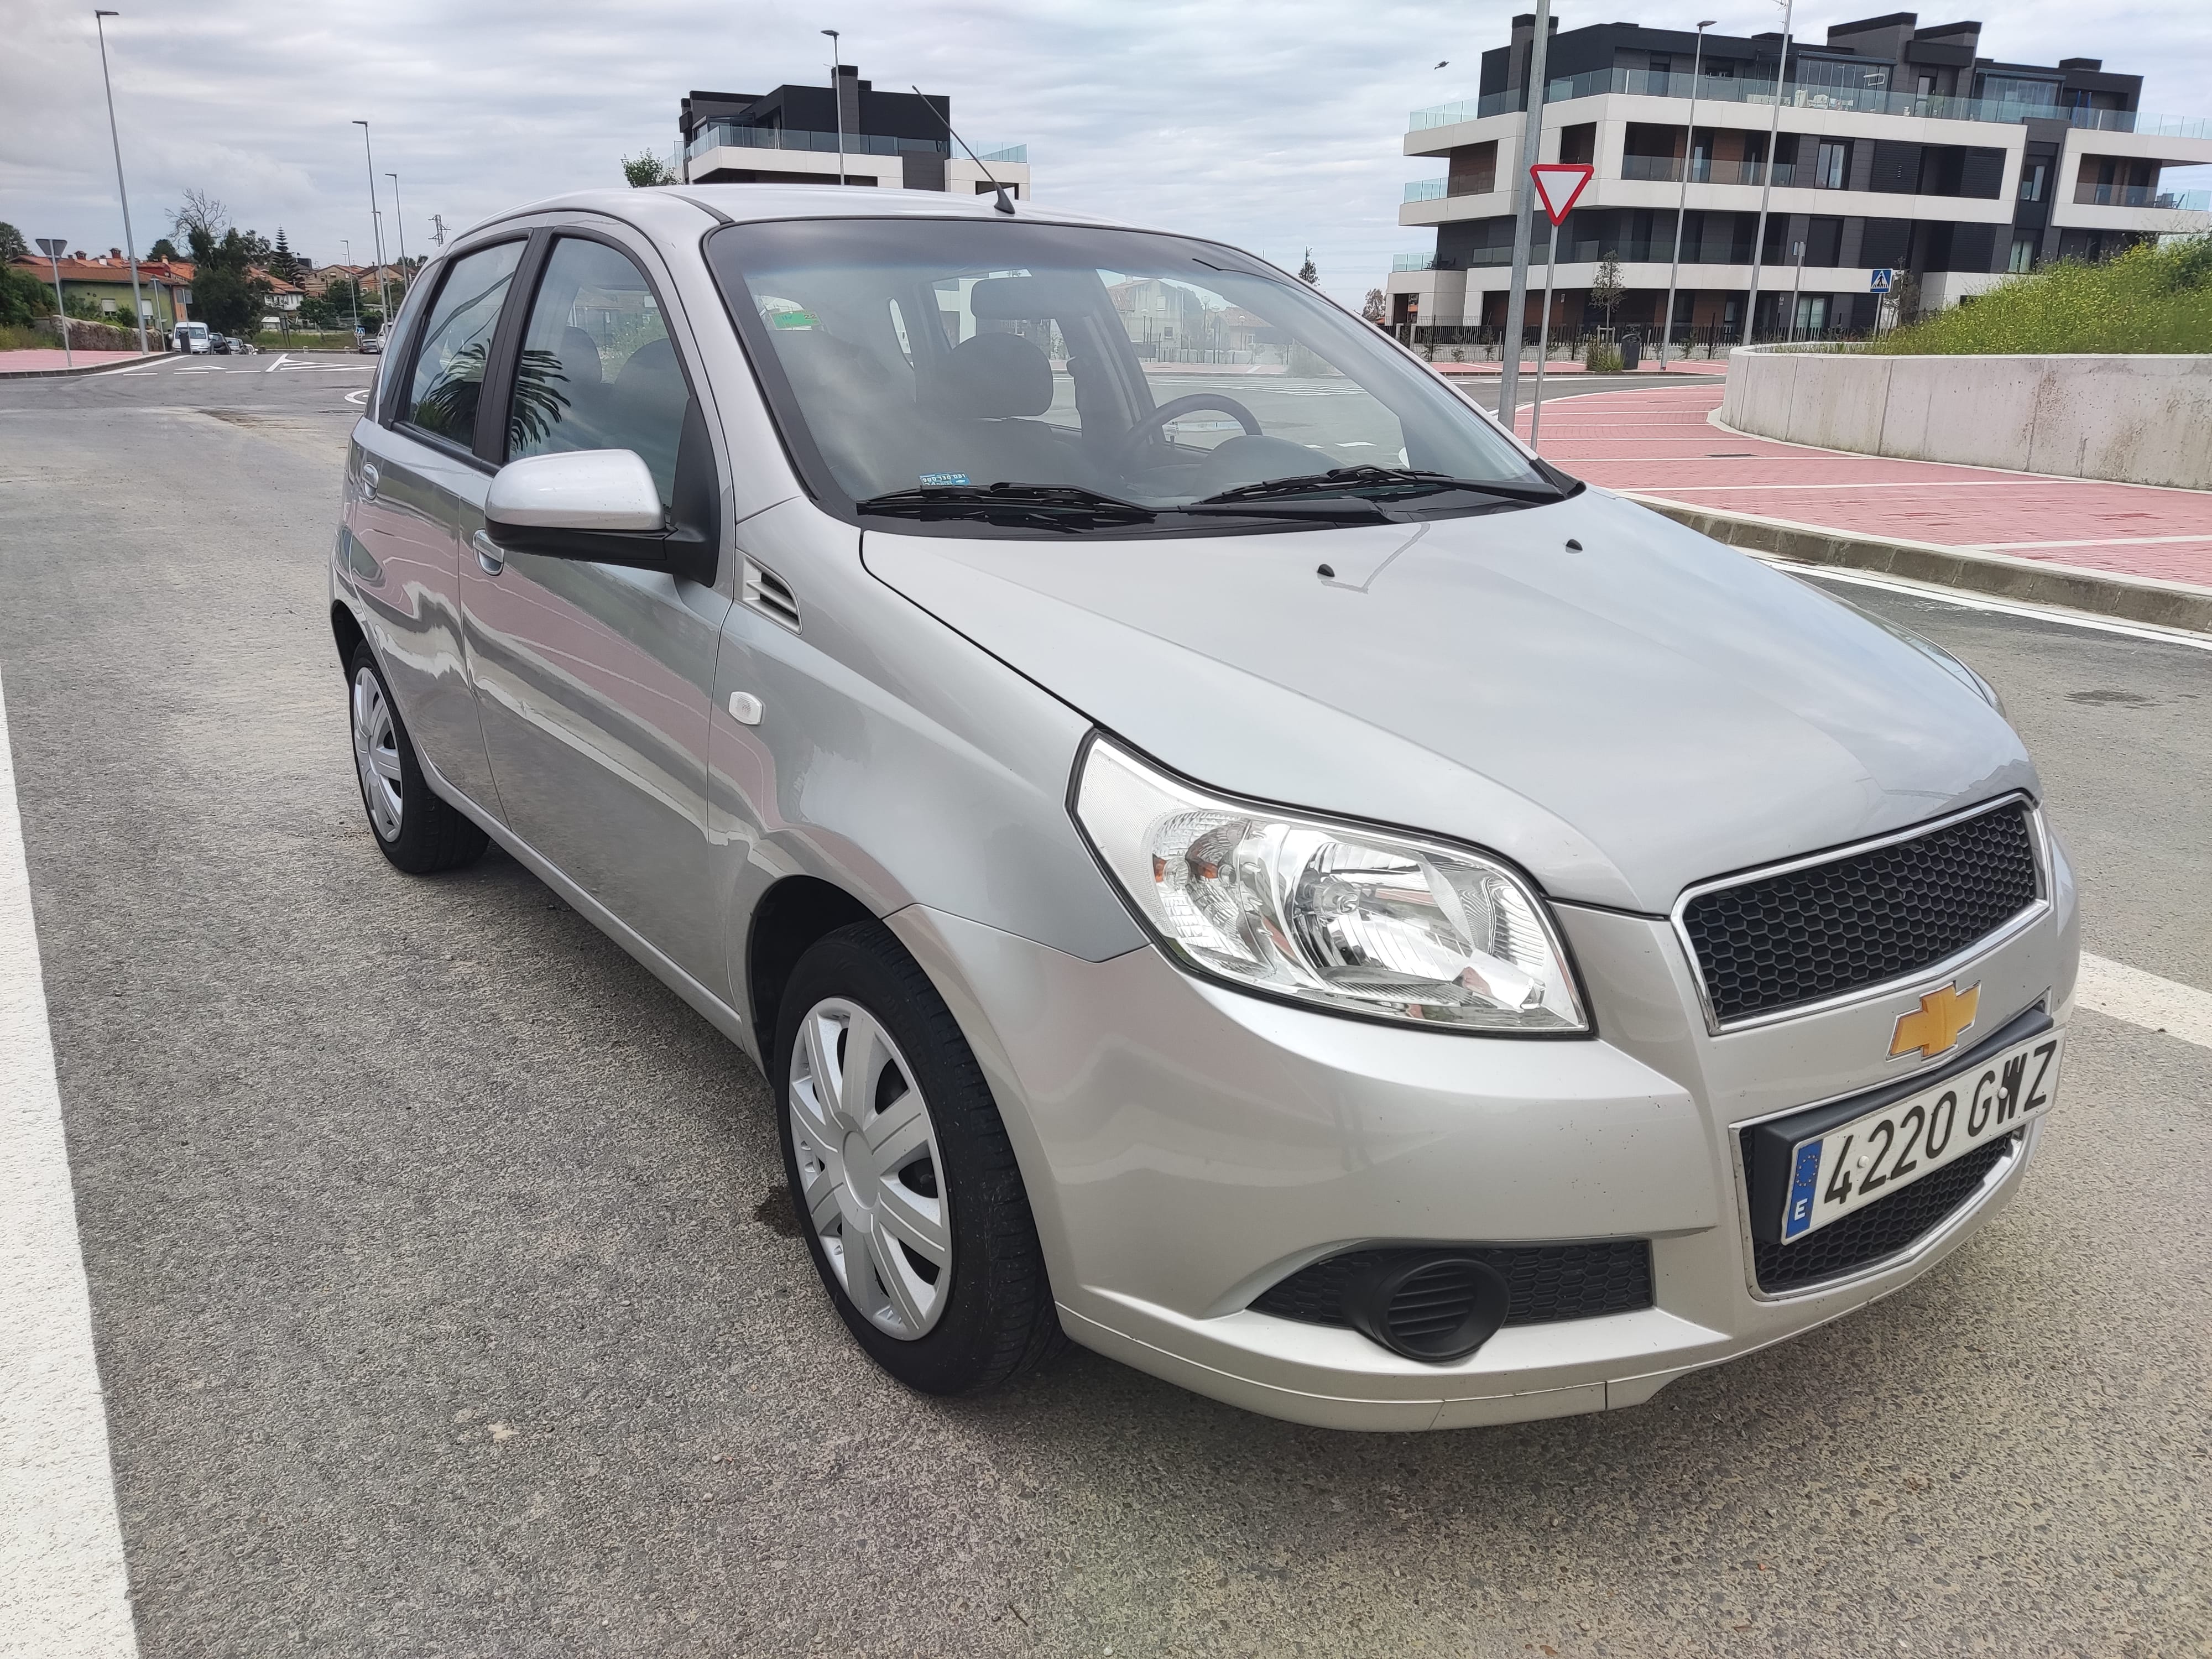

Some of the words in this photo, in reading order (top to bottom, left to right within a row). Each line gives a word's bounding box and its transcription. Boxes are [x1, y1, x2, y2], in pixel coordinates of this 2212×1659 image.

[1824, 1091, 1957, 1204] 4220
[1967, 1039, 2057, 1137] GWZ
[1794, 1199, 1808, 1220] E
